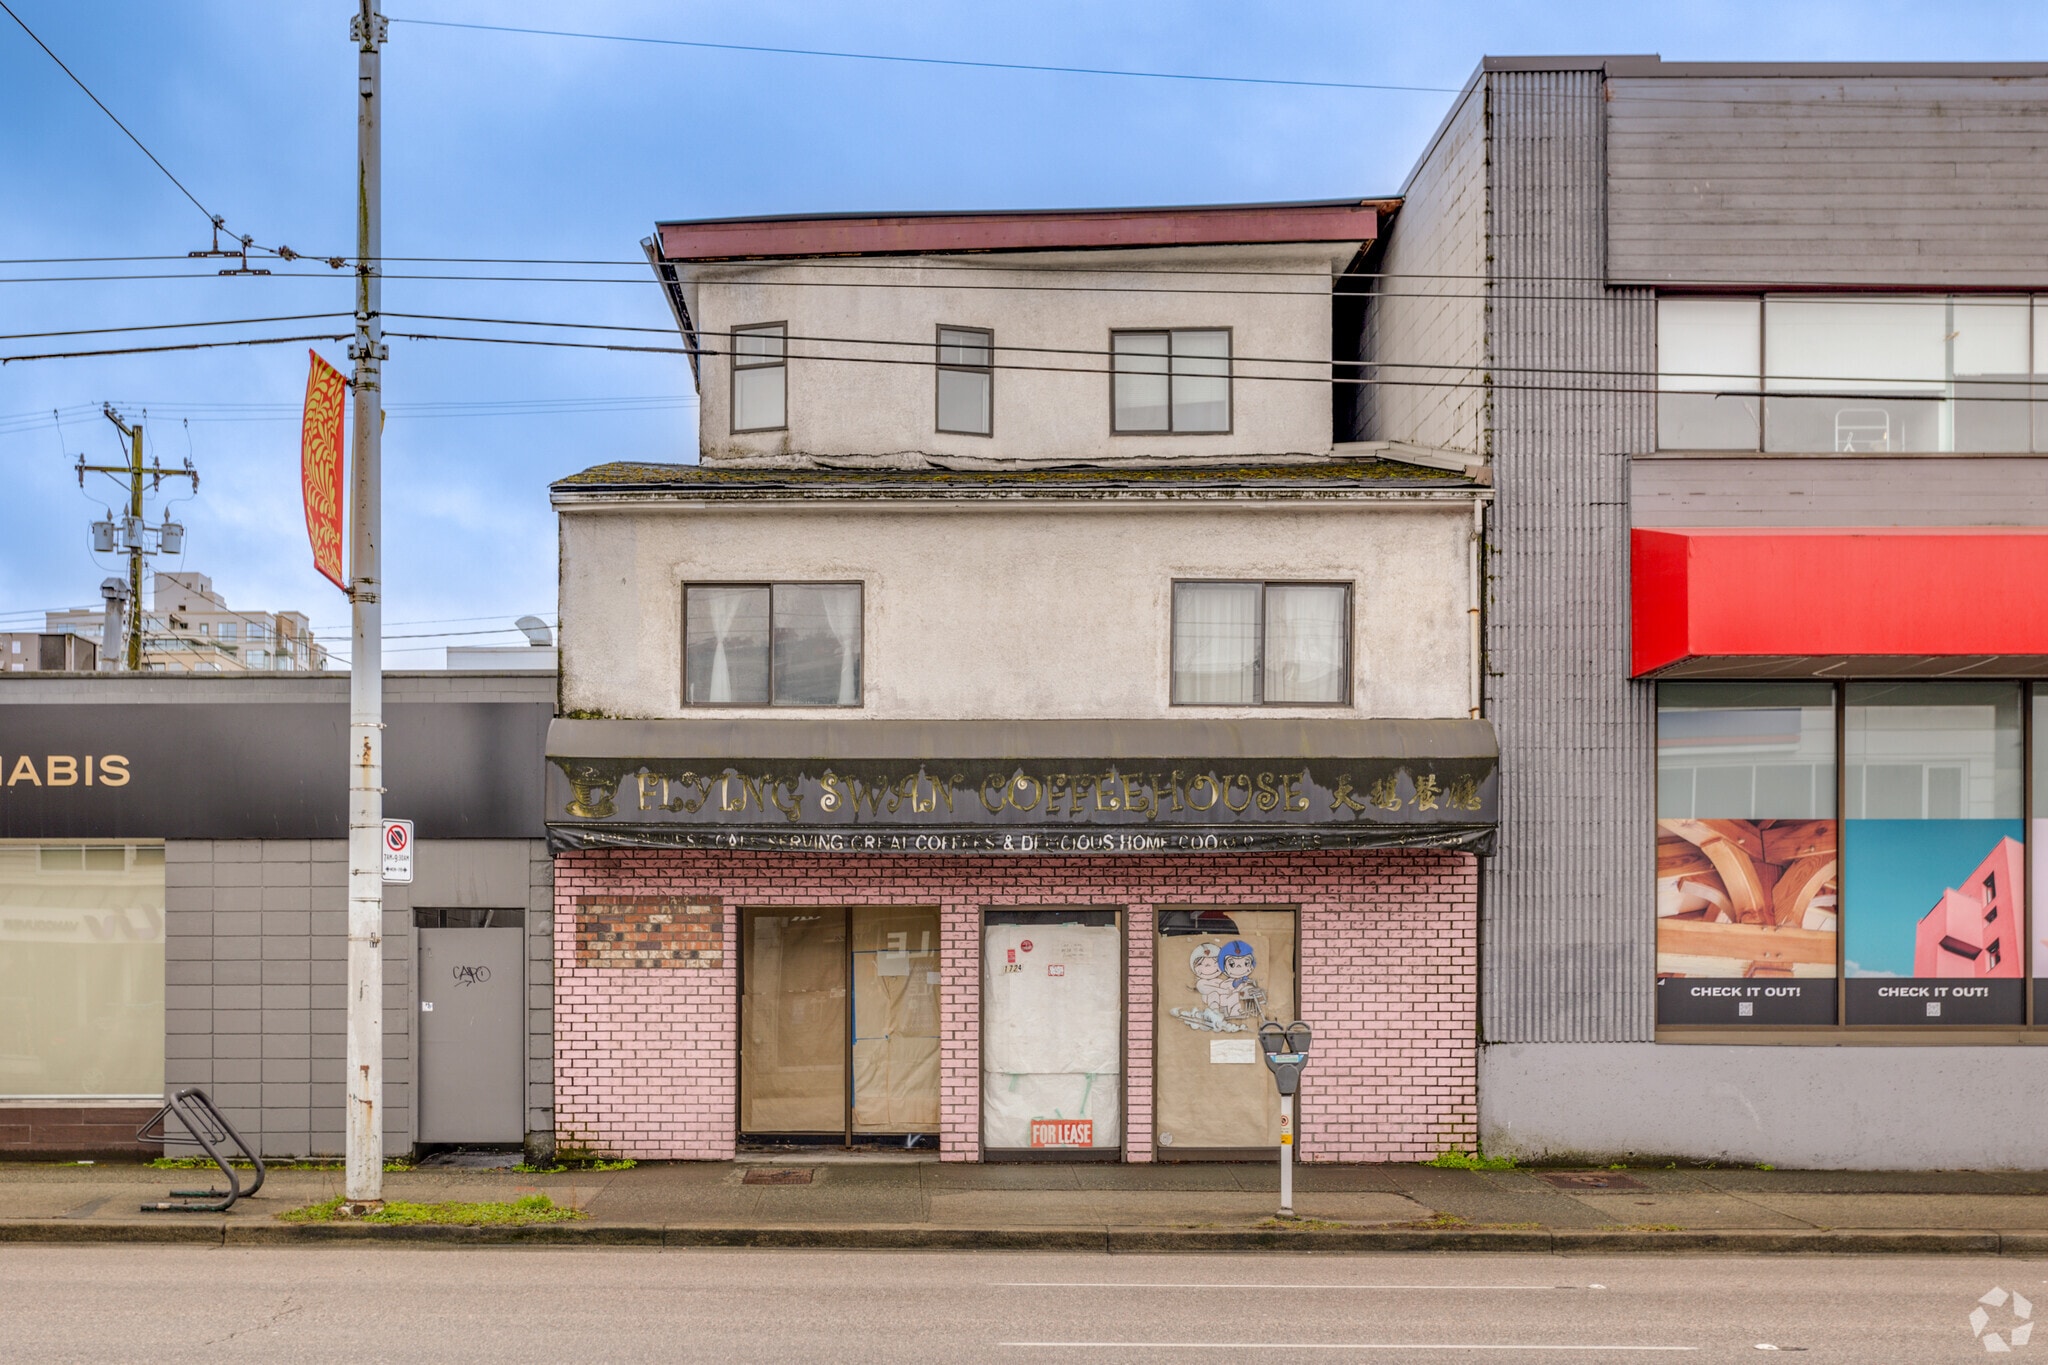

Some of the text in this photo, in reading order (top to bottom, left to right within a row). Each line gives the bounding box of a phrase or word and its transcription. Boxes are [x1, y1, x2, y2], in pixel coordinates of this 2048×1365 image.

[0, 754, 131, 787] ABIS
[637, 771, 804, 822] FLYING
[820, 772, 965, 814] SWAN
[1003, 834, 1014, 850] &
[1021, 834, 1114, 850] DECIOUS
[1178, 834, 1254, 850] COOKD
[1004, 964, 1022, 973] 1724
[1690, 987, 1801, 997] CHECK IT OUT!
[1878, 987, 1989, 997] CHECK IT OUT!
[1033, 1124, 1091, 1144] FOR LEASE
